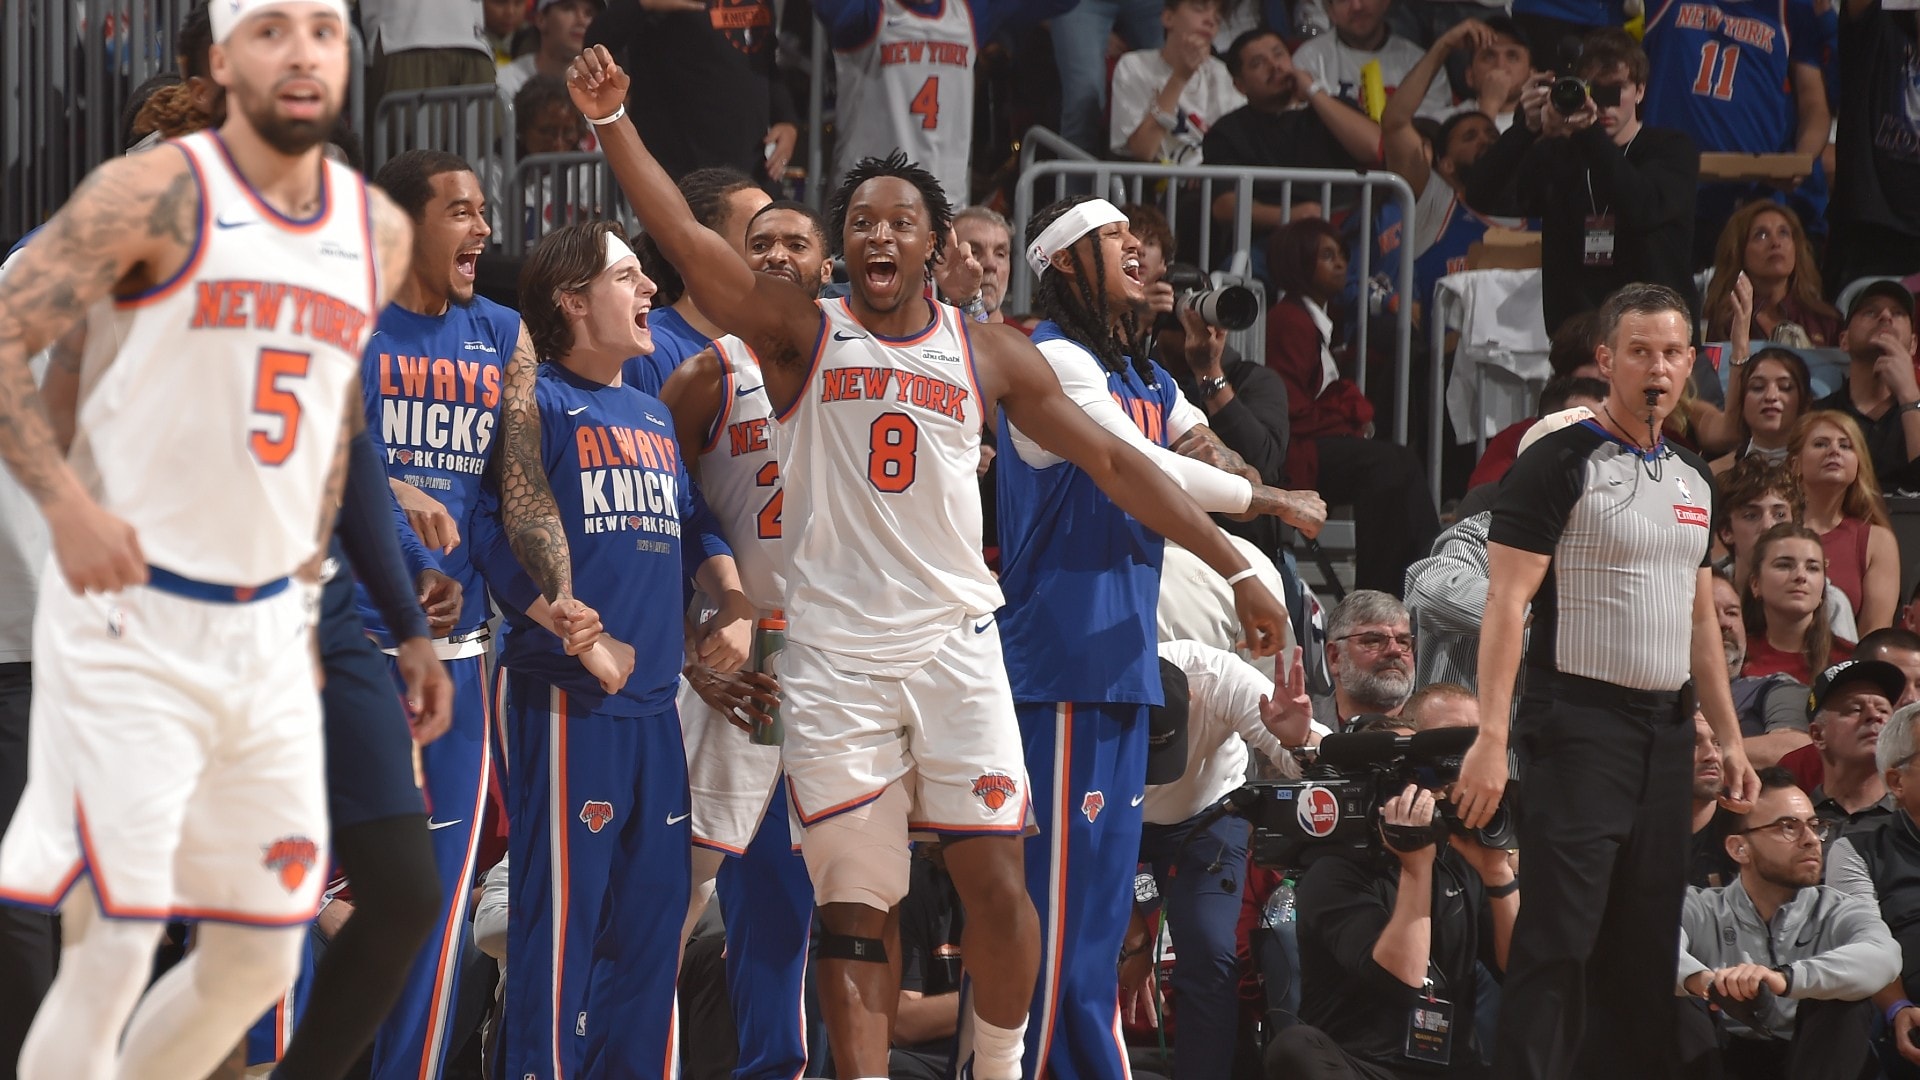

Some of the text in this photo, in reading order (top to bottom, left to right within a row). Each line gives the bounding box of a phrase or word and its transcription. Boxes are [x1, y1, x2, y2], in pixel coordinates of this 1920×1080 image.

[1675, 3, 1775, 55] NEW YORK
[881, 41, 968, 69] NEW YORK
[1692, 40, 1740, 101] 11
[910, 75, 939, 130] 4
[189, 279, 368, 353] NEW YORK
[379, 353, 500, 409] LWAYS
[938, 354, 960, 363] dhabi
[248, 347, 311, 467] 5
[821, 367, 968, 424] NEW YORK
[382, 399, 494, 454] NICKS
[576, 425, 677, 476] ALWAYS
[728, 417, 769, 458] NE
[387, 447, 434, 468] YRK
[868, 412, 918, 493] 8
[580, 469, 679, 520] KNICK
[584, 515, 680, 540] NEW YRK FORE
[973, 775, 1016, 795] KNICKS
[1348, 803, 1354, 813] 8
[1314, 814, 1334, 822] ESPN
